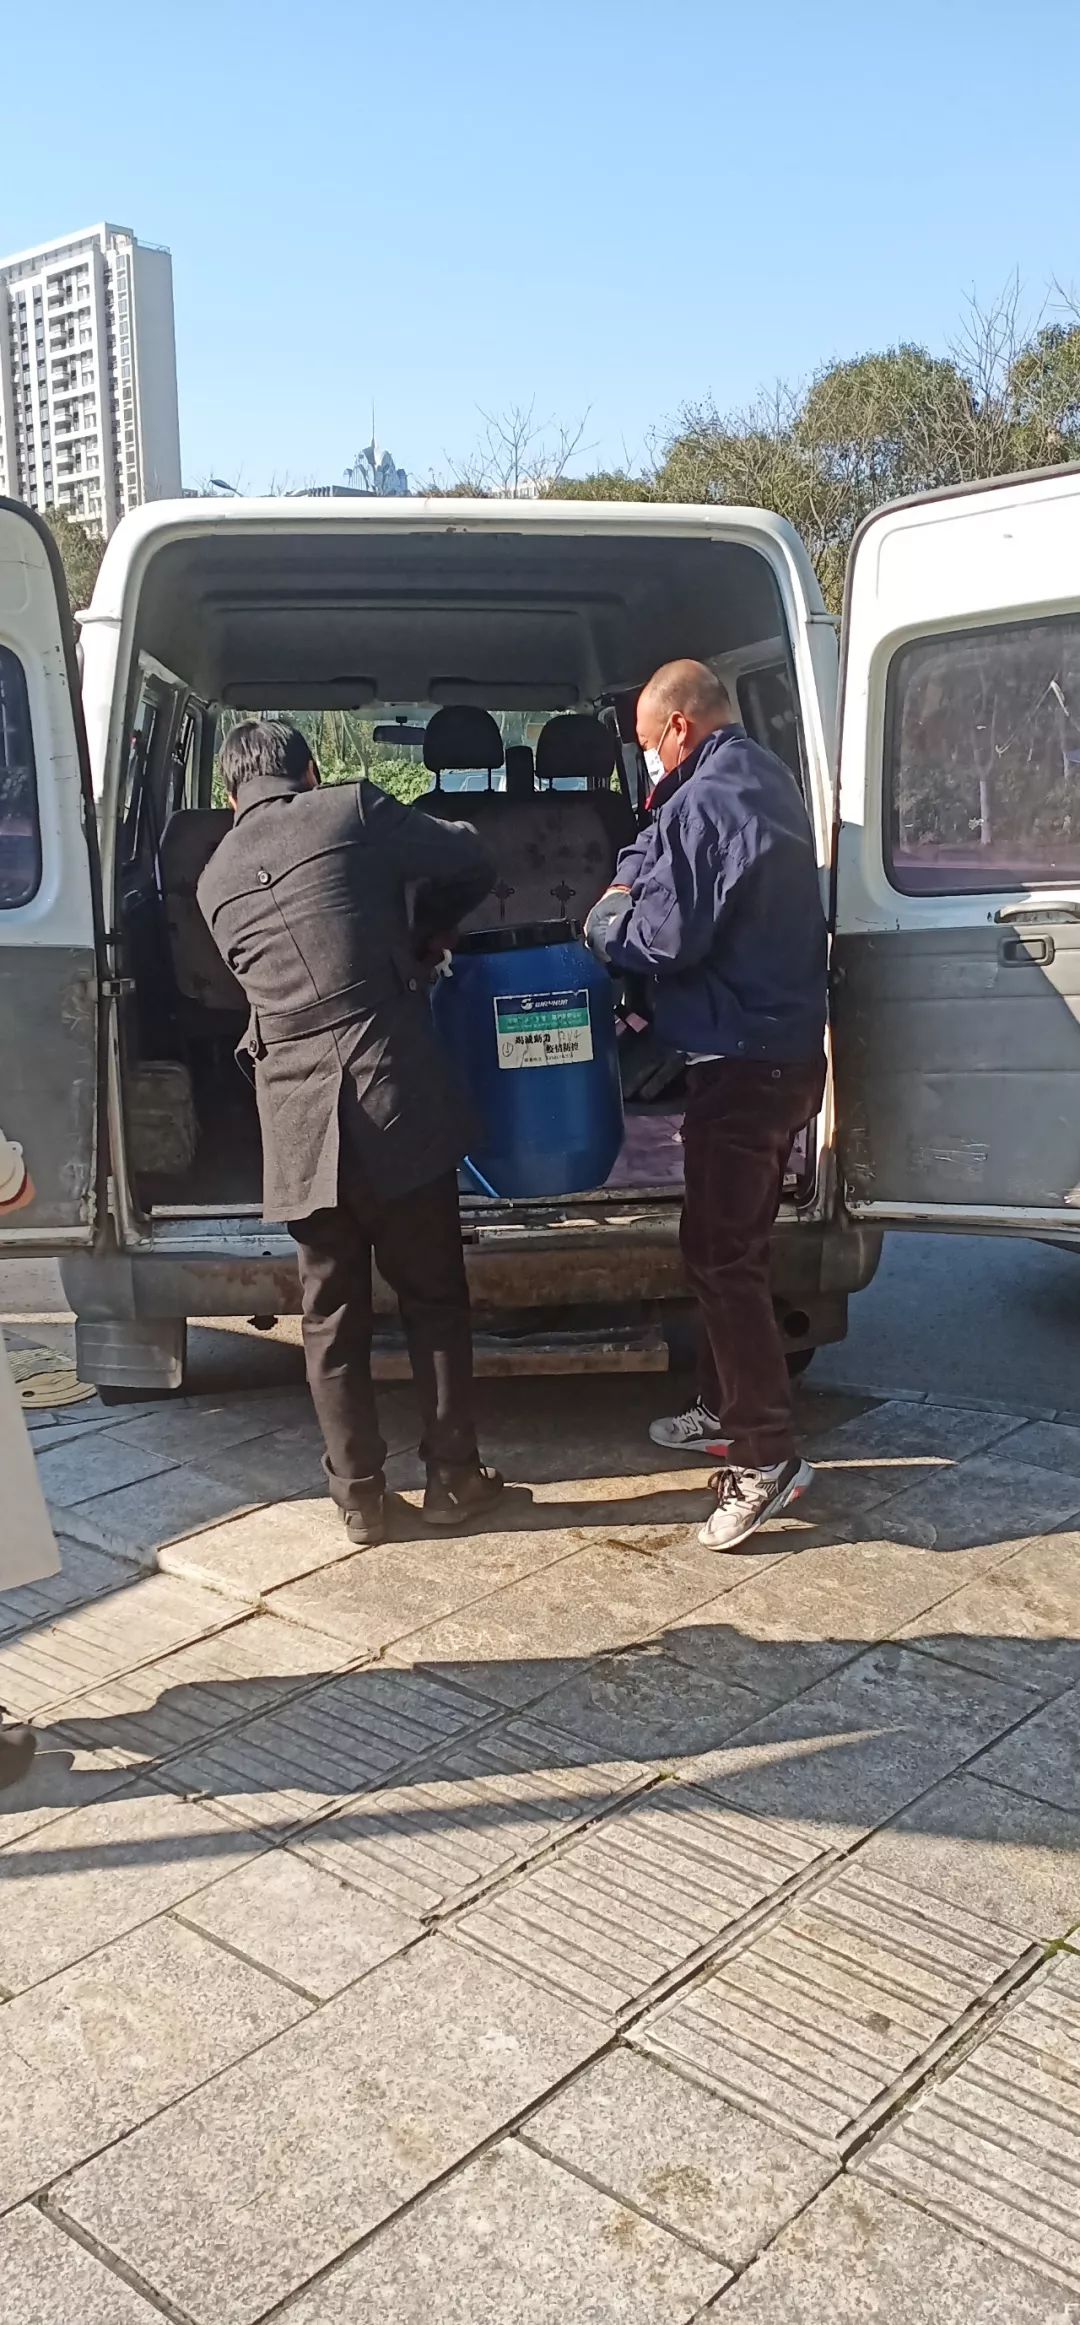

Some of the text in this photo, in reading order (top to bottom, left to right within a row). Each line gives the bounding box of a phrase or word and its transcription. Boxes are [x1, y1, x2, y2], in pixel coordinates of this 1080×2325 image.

[546, 1042, 579, 1054] 疫情防控
[680, 1415, 698, 1435] N
